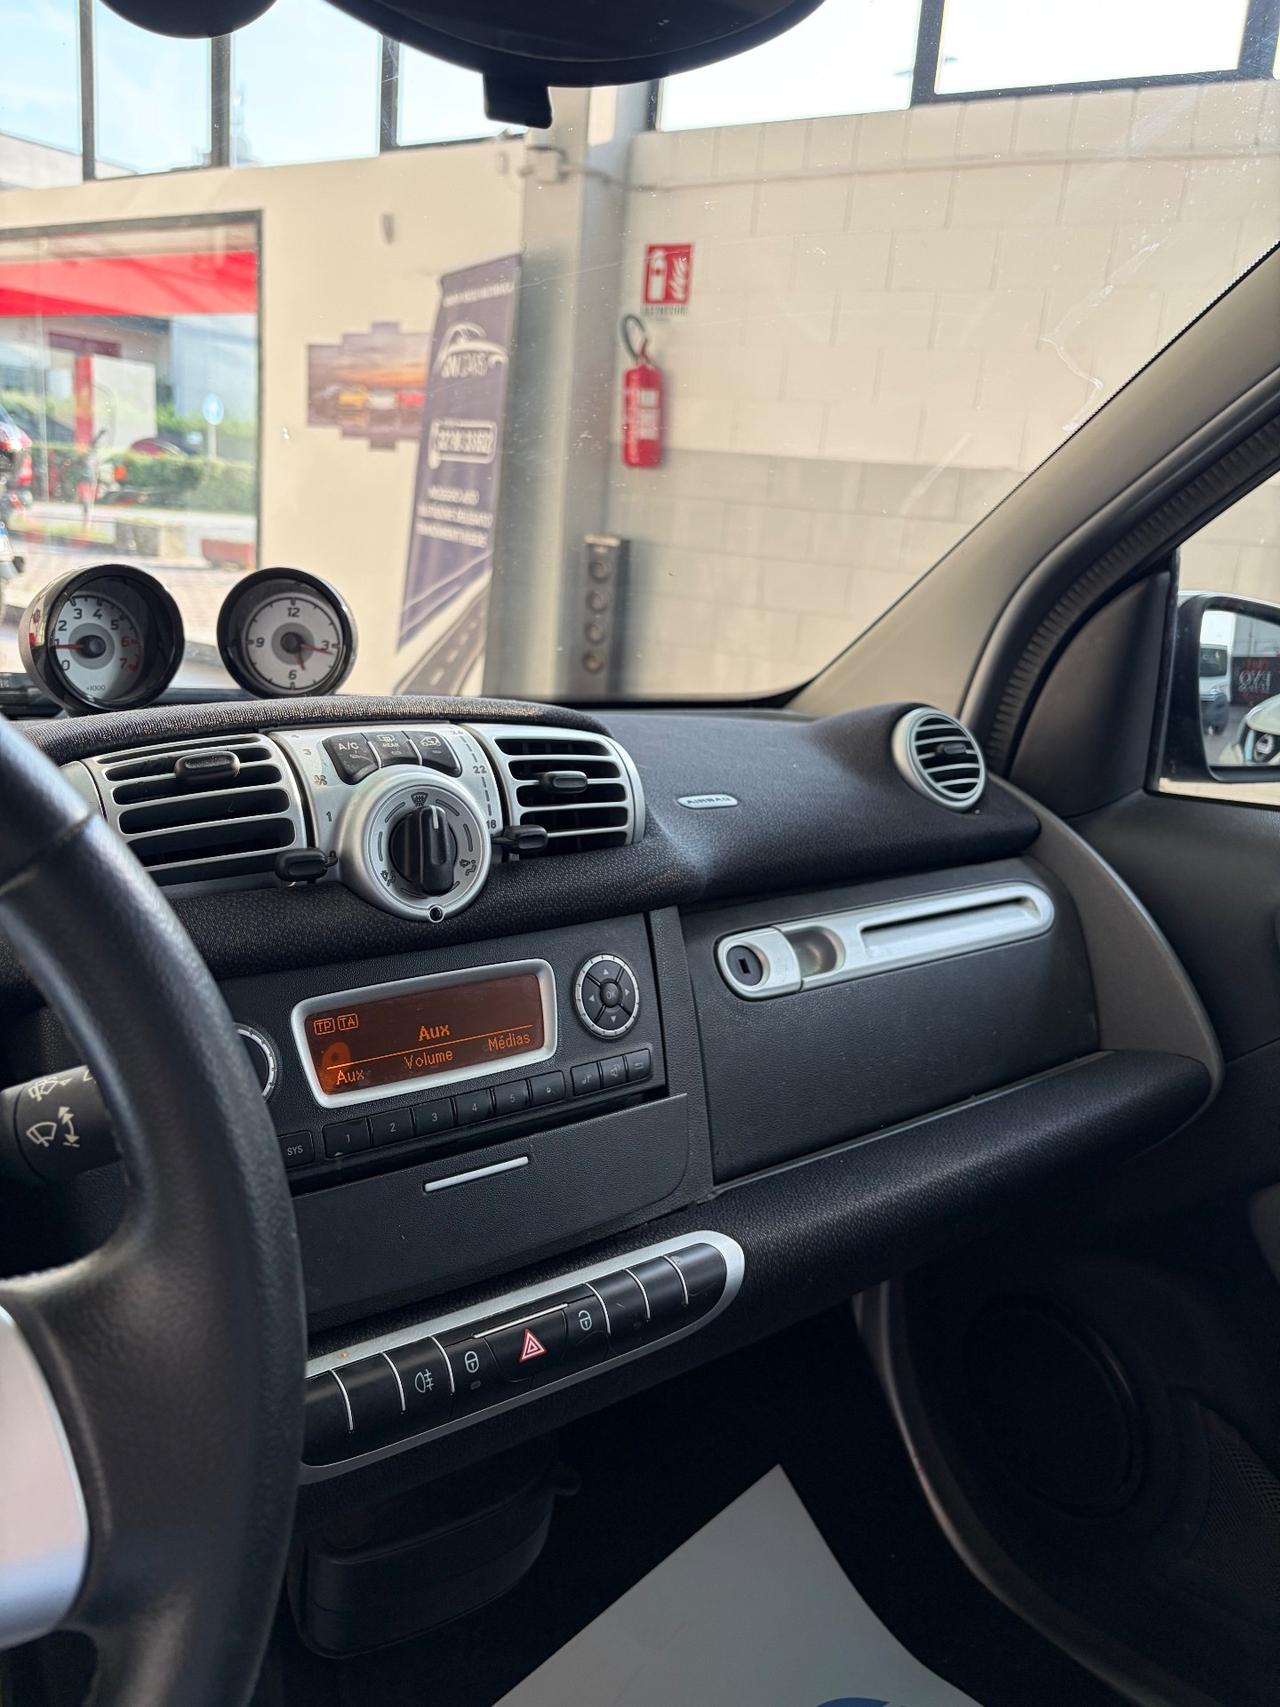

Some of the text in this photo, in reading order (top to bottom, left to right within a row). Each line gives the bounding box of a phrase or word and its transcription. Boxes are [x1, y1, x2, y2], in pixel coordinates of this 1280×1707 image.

[73, 608, 82, 619] 3
[93, 608, 103, 619] 4
[287, 607, 300, 618] 12
[58, 620, 67, 631] 2
[110, 619, 119, 630] 5
[121, 636, 130, 647] 6
[255, 637, 265, 648] 9
[321, 640, 329, 651] 3
[61, 659, 70, 671] 0
[119, 657, 128, 669] 7
[288, 669, 297, 680] 6
[338, 741, 360, 750] A/C
[472, 765, 487, 774] 22
[486, 820, 497, 830] 18
[317, 1016, 356, 1031] TP TA
[418, 1024, 450, 1041] Aux
[335, 1034, 531, 1086] Aux Volume Médias
[509, 1094, 516, 1103] 5
[471, 1103, 478, 1112] 4
[431, 1112, 439, 1123] 3
[389, 1122, 397, 1133] 2
[345, 1133, 351, 1144] 1
[287, 1144, 304, 1156] SYS
